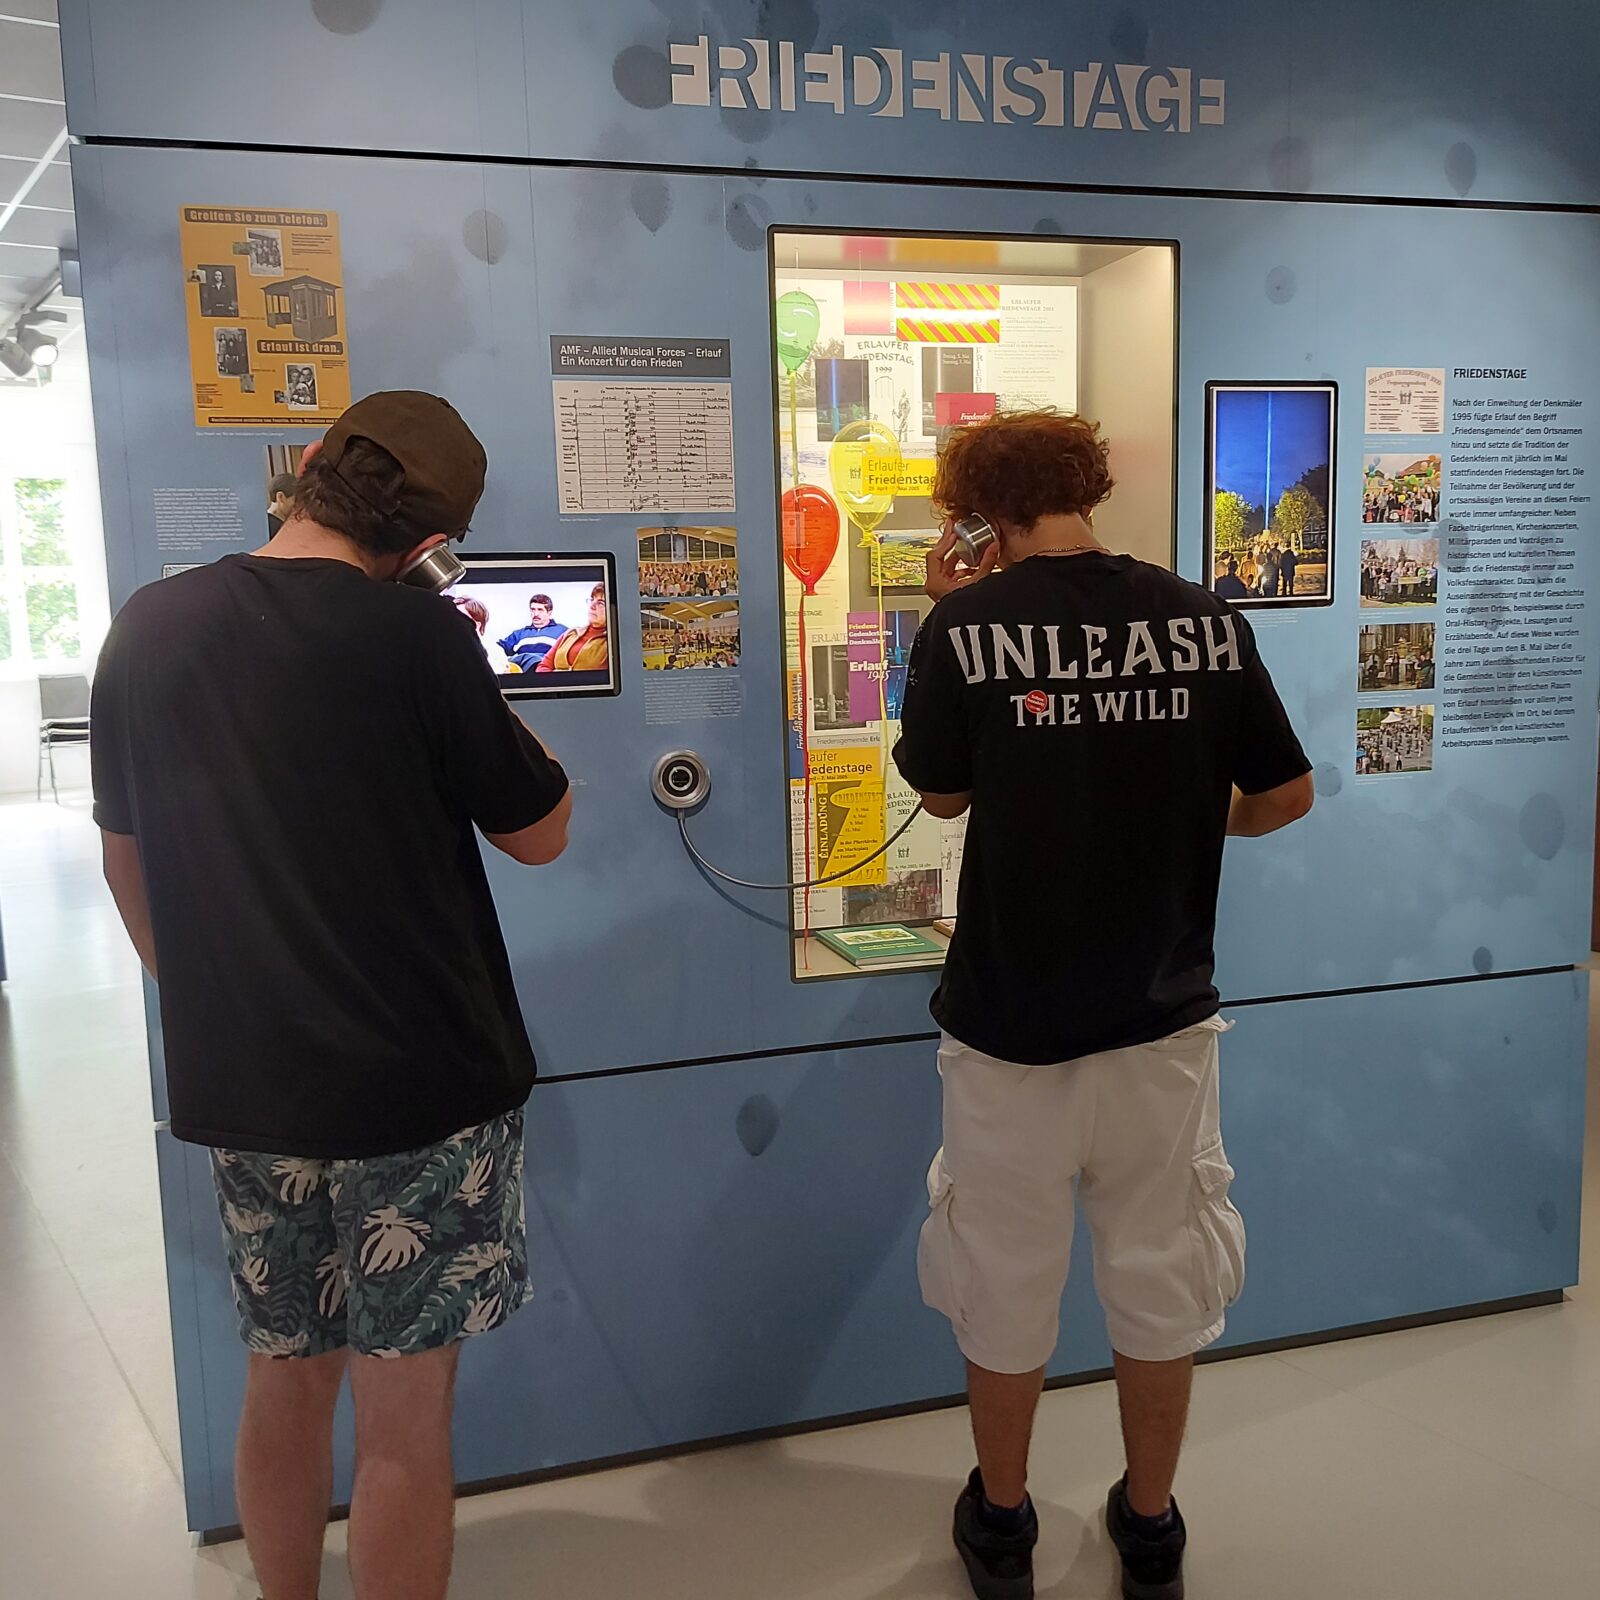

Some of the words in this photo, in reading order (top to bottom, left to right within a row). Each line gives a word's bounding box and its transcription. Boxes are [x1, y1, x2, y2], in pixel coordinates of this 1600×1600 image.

[670, 35, 1225, 132] FRIEDENSTAGE
[190, 210, 231, 222] Greifen
[234, 212, 252, 222] Sie
[255, 214, 276, 224] zum
[260, 342, 292, 352] Erlauf
[296, 342, 310, 352] ist
[312, 343, 340, 353] dran.
[560, 346, 581, 355] AMF
[592, 346, 617, 356] Allied
[620, 346, 654, 356] Musical
[657, 348, 686, 357] Forces
[696, 348, 722, 358] Erlauf
[561, 356, 575, 365] Ein
[578, 356, 613, 366] Konzert
[616, 357, 629, 366] für
[631, 358, 647, 367] den
[650, 358, 683, 368] Frieden
[1454, 368, 1528, 379] FRIEDENSTAGE
[1473, 399, 1485, 407] der
[1487, 400, 1528, 408] Einweihung
[1473, 413, 1492, 422] fügte
[1533, 413, 1557, 422] Begriff
[1515, 455, 1541, 463] jährlich
[868, 458, 909, 472] Erlaufer
[1504, 468, 1554, 477] Friedenstagen
[869, 474, 937, 487] Friedenstag
[1488, 482, 1501, 490] der
[1502, 482, 1546, 491] Bevölkerung
[1449, 496, 1504, 505] ortsansässigen
[1569, 495, 1591, 503] Feiern
[1554, 509, 1576, 517] Neben
[1519, 537, 1554, 546] Vorträgen
[1447, 551, 1491, 559] historischen
[1485, 564, 1530, 573] Friedenstage
[1517, 577, 1536, 585] Dazu
[1446, 591, 1518, 601] Auseinandersetzung
[1546, 589, 1584, 597] Geschichte
[1460, 605, 1489, 615] eigenen
[1513, 603, 1563, 613] beispielsweise
[1524, 617, 1558, 626] Lesungen
[1559, 616, 1573, 624] und
[1497, 631, 1509, 639] Auf
[1554, 629, 1579, 637] wurden
[948, 614, 1243, 684] UNLEASH
[1457, 646, 1472, 654] drei
[1474, 645, 1490, 655] Tage
[1505, 644, 1519, 652] den
[1561, 642, 1572, 650] die
[1552, 655, 1574, 663] Faktor
[849, 660, 888, 672] Erlauf
[1517, 670, 1531, 678] den
[1550, 682, 1571, 690] Raum
[1457, 699, 1479, 707] Erlauf
[1536, 695, 1556, 703] allem
[1557, 695, 1573, 704] jene
[1010, 693, 1081, 727] THE
[1092, 688, 1190, 722] WILD
[1442, 712, 1482, 721] bleibenden
[1483, 710, 1514, 719] Eindruck
[1553, 708, 1575, 716] denen
[1500, 724, 1513, 732] den
[1441, 738, 1493, 749] Arbeitsprozess
[1494, 736, 1546, 747] miteinbezogen
[809, 750, 838, 762] aufer
[808, 764, 872, 775] iedenstage
[887, 791, 919, 800] RLAUFE
